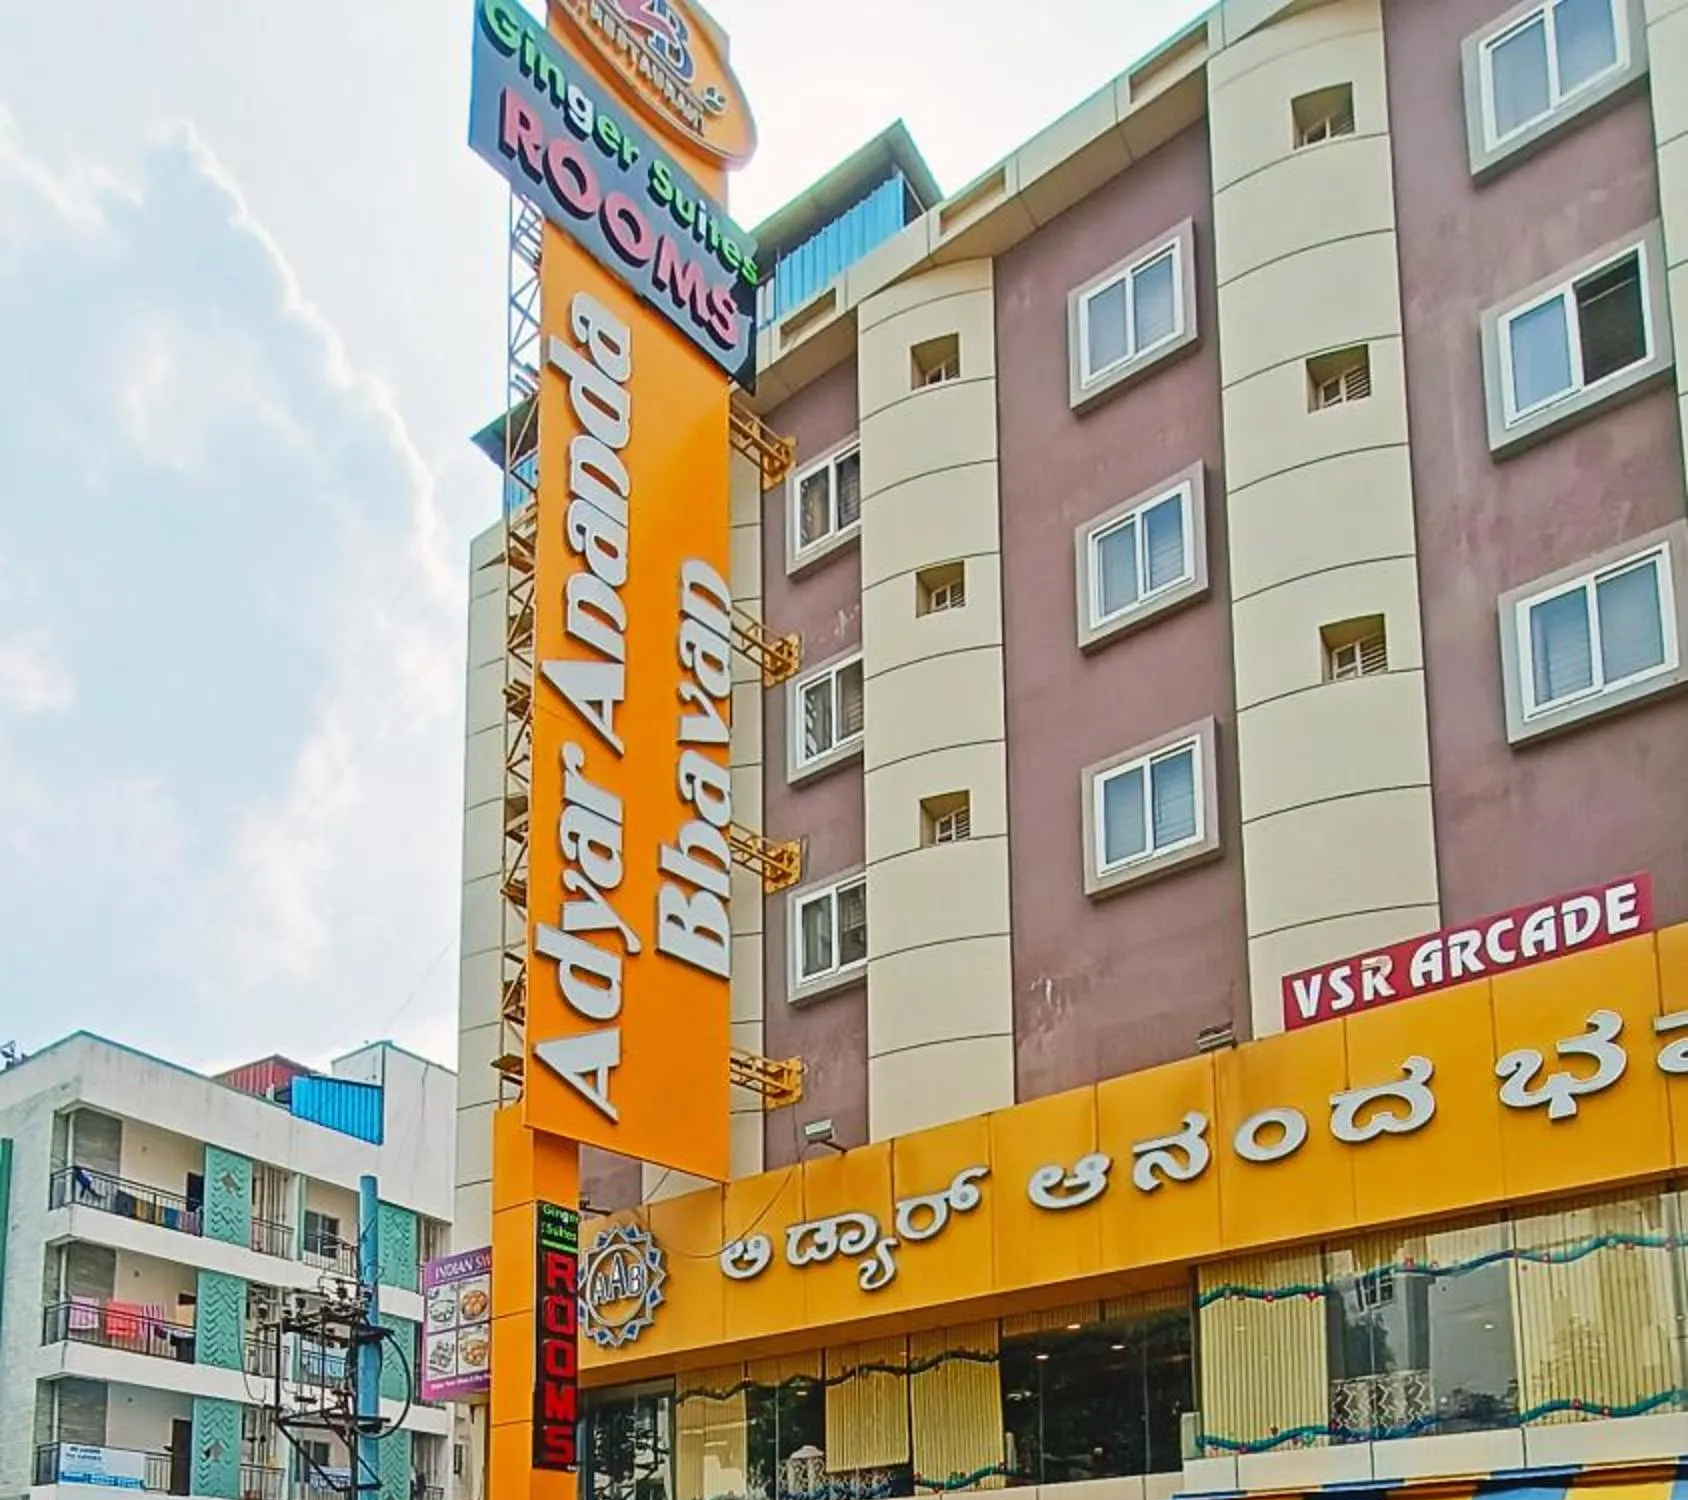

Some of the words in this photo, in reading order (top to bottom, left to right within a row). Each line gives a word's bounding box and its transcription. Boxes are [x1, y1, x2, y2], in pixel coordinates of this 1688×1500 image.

[481, 0, 640, 168] Ginger
[650, 157, 760, 286] Suites
[501, 85, 739, 350] ROOMS
[540, 291, 632, 757] Ananda
[656, 558, 732, 981] Bhavan
[533, 741, 641, 1125] Adyar
[1292, 956, 1397, 1019] VSR
[1409, 882, 1641, 989] ARCADE
[435, 1258, 473, 1280] INDIAN
[543, 1251, 577, 1464] ROOMS
